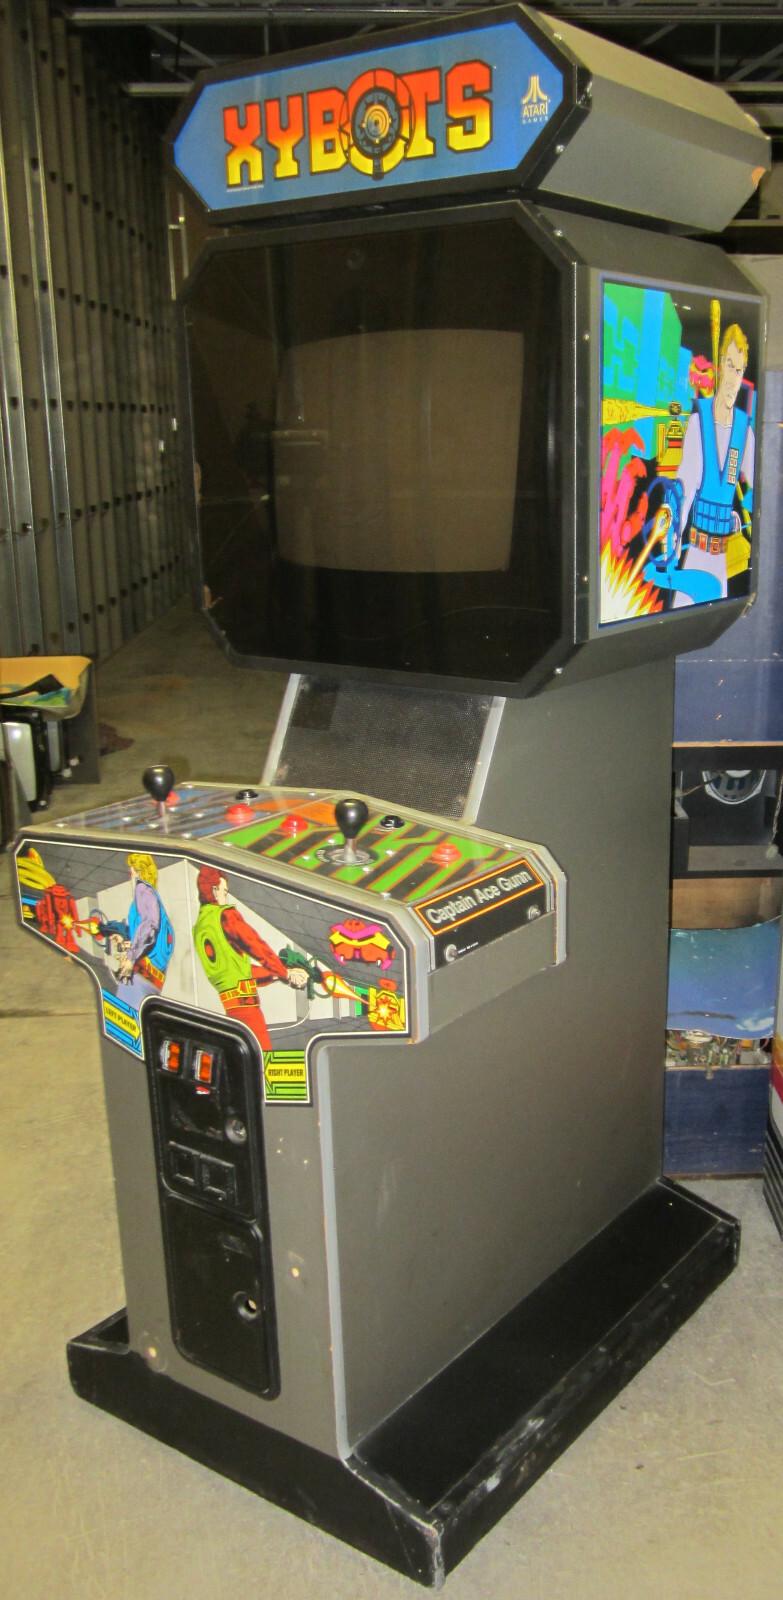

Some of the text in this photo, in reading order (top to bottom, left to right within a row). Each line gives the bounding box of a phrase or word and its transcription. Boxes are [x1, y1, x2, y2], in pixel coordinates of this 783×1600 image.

[223, 59, 493, 188] XYBOTS
[522, 102, 548, 118] ATARI
[426, 871, 533, 924] Captain Ace Gunn
[105, 1006, 137, 1033] LEFT PLAYER
[268, 1068, 304, 1077] RIGHT PLAYER
